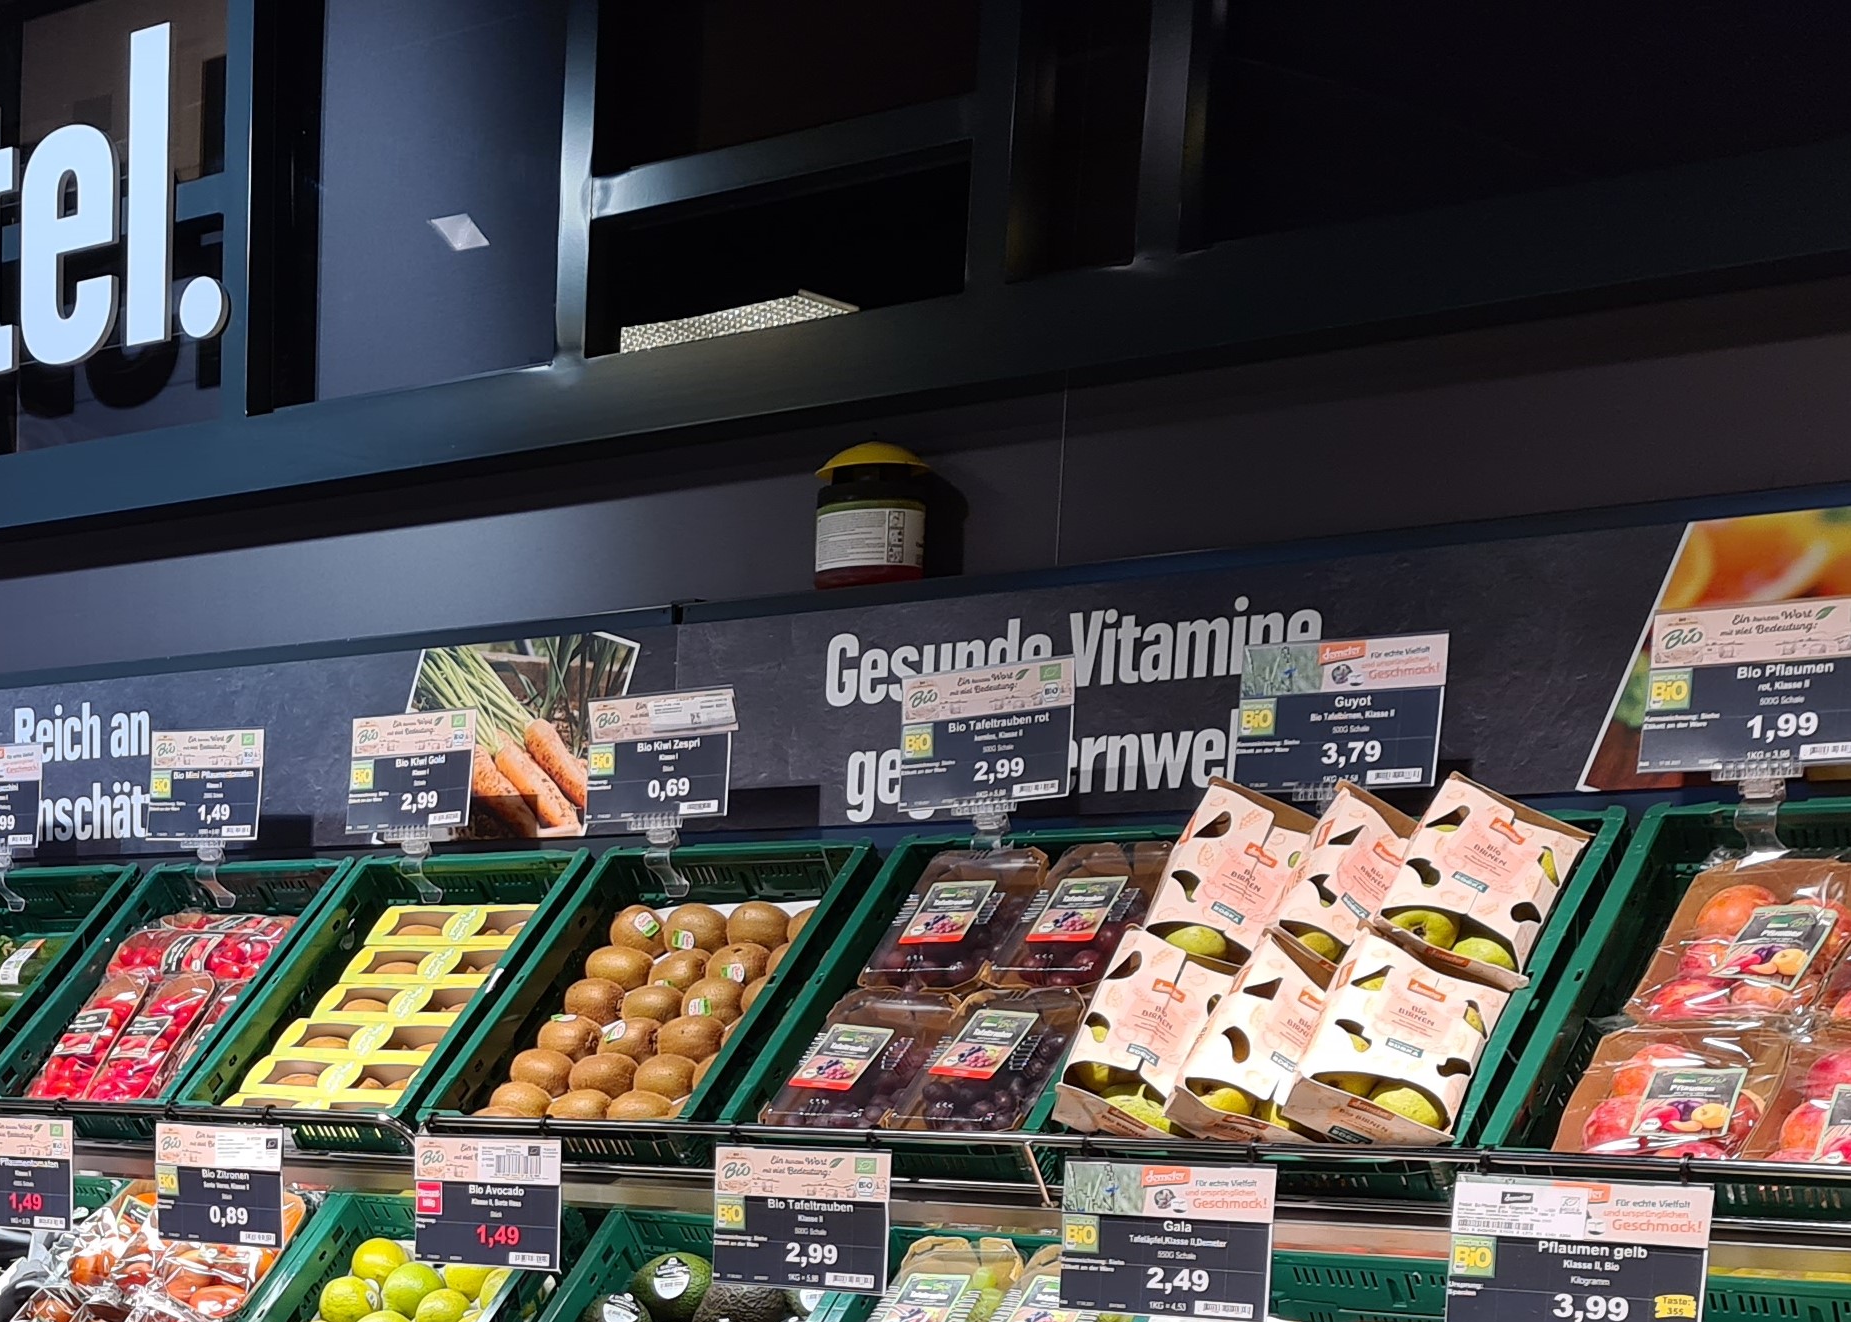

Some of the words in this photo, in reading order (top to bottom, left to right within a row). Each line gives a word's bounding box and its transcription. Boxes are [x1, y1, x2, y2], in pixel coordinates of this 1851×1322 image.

[1661, 627, 1704, 650] Bio
[1368, 665, 1441, 681] Geschmack!
[1736, 666, 1762, 679] Bio
[1765, 661, 1835, 678] Pflaumen
[1334, 695, 1372, 710] Guyot
[948, 721, 967, 733] Bio
[968, 714, 1032, 731] Tafeltrauben
[1034, 712, 1050, 724] rot
[1746, 712, 1819, 743] 1,99
[110, 709, 150, 758] an
[637, 742, 654, 753] Bio
[1321, 740, 1381, 768] 3,79
[973, 757, 1025, 784] 2,99
[647, 777, 690, 802] 0,69
[401, 791, 438, 815] 2,99
[198, 804, 230, 824] 1,49
[722, 1162, 751, 1179] Bio
[468, 1184, 484, 1195] Bio
[485, 1185, 525, 1197] Avocado
[9, 1192, 43, 1213] 1,49
[767, 1199, 786, 1210] Bio
[787, 1199, 854, 1213] Tafeltrauben
[1192, 1198, 1268, 1209] Geschmack!
[209, 1205, 249, 1227] 0,89
[1612, 1219, 1703, 1233] Geschmack!
[476, 1224, 520, 1249] 1,49
[1163, 1220, 1192, 1234] Gala
[785, 1242, 838, 1267] 2,99
[1538, 1241, 1609, 1257] Pflaumen
[1613, 1245, 1648, 1261] gelb
[1563, 1259, 1593, 1270] Klasse
[1604, 1261, 1620, 1272] Bio
[1145, 1266, 1210, 1294] 2,49
[1662, 1296, 1691, 1306] Taste:
